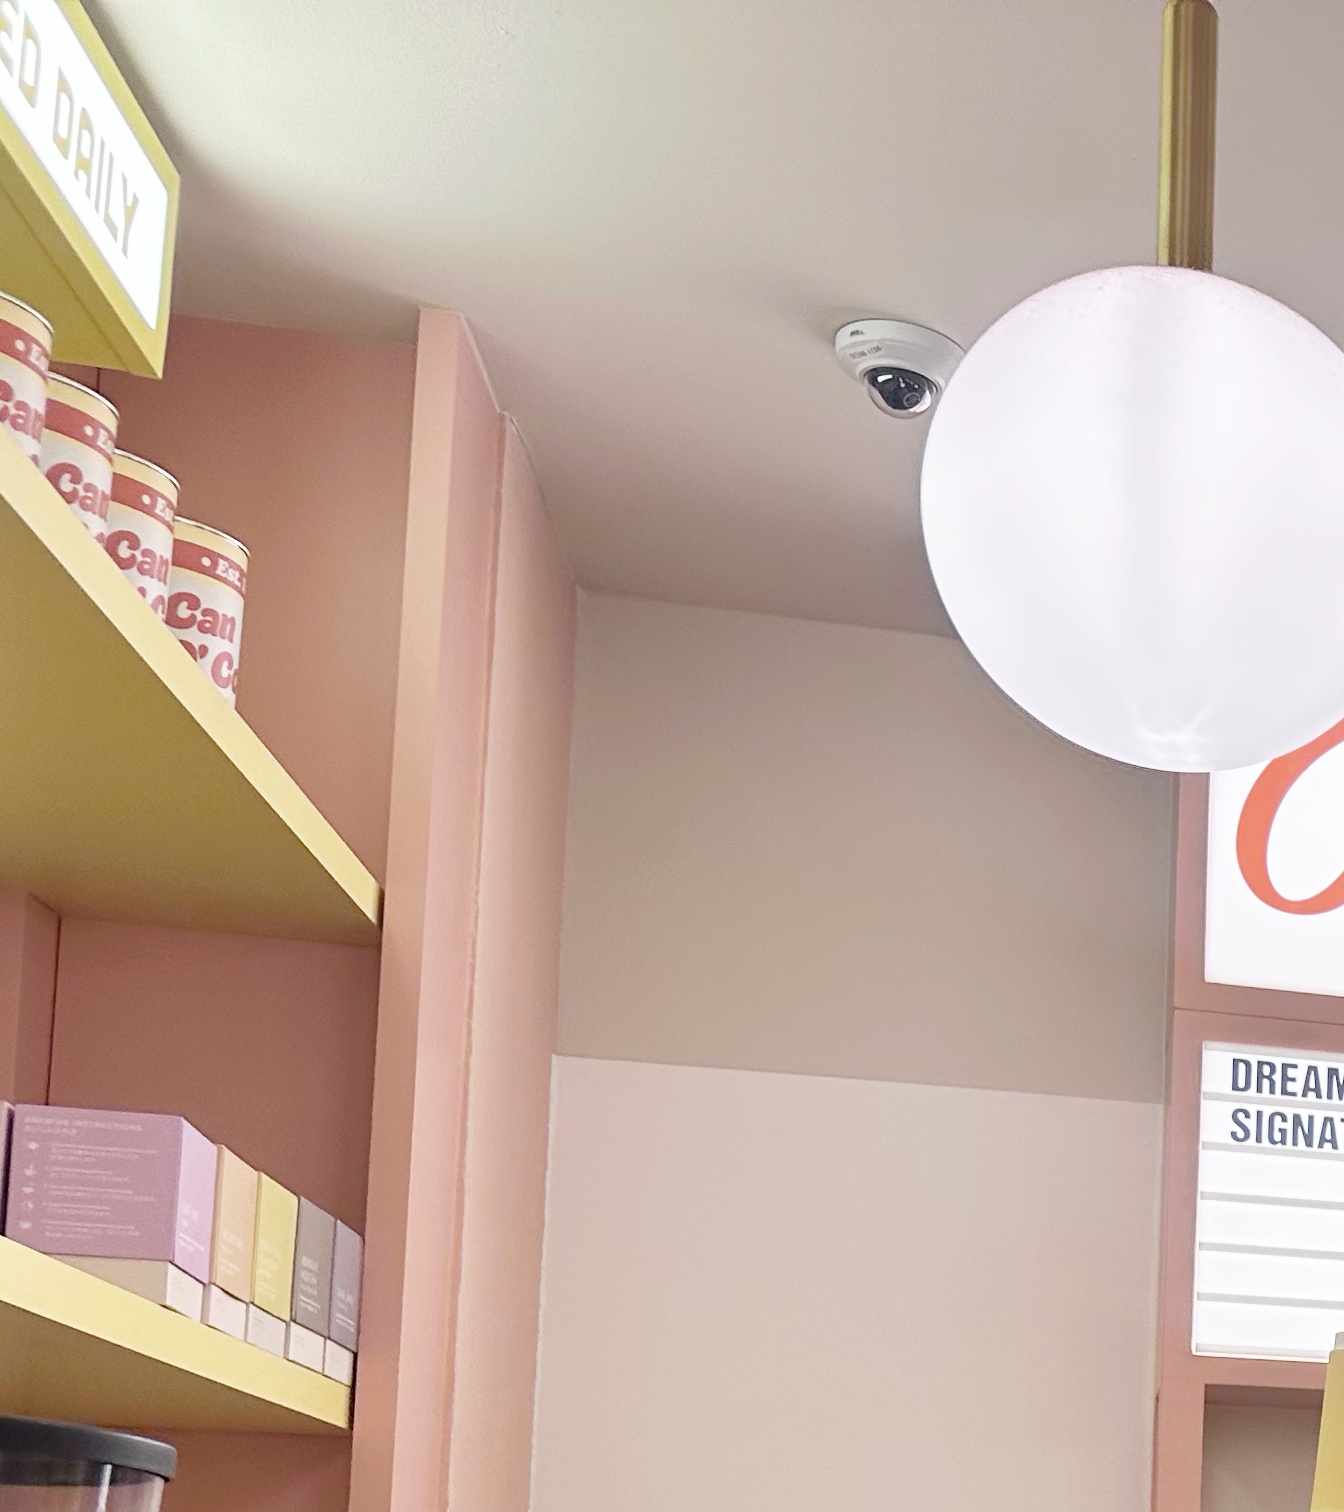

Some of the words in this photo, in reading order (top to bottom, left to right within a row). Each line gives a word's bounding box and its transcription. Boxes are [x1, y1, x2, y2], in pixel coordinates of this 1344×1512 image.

[52, 65, 139, 259] DAILY
[105, 530, 169, 585] Can
[165, 591, 236, 643] Can
